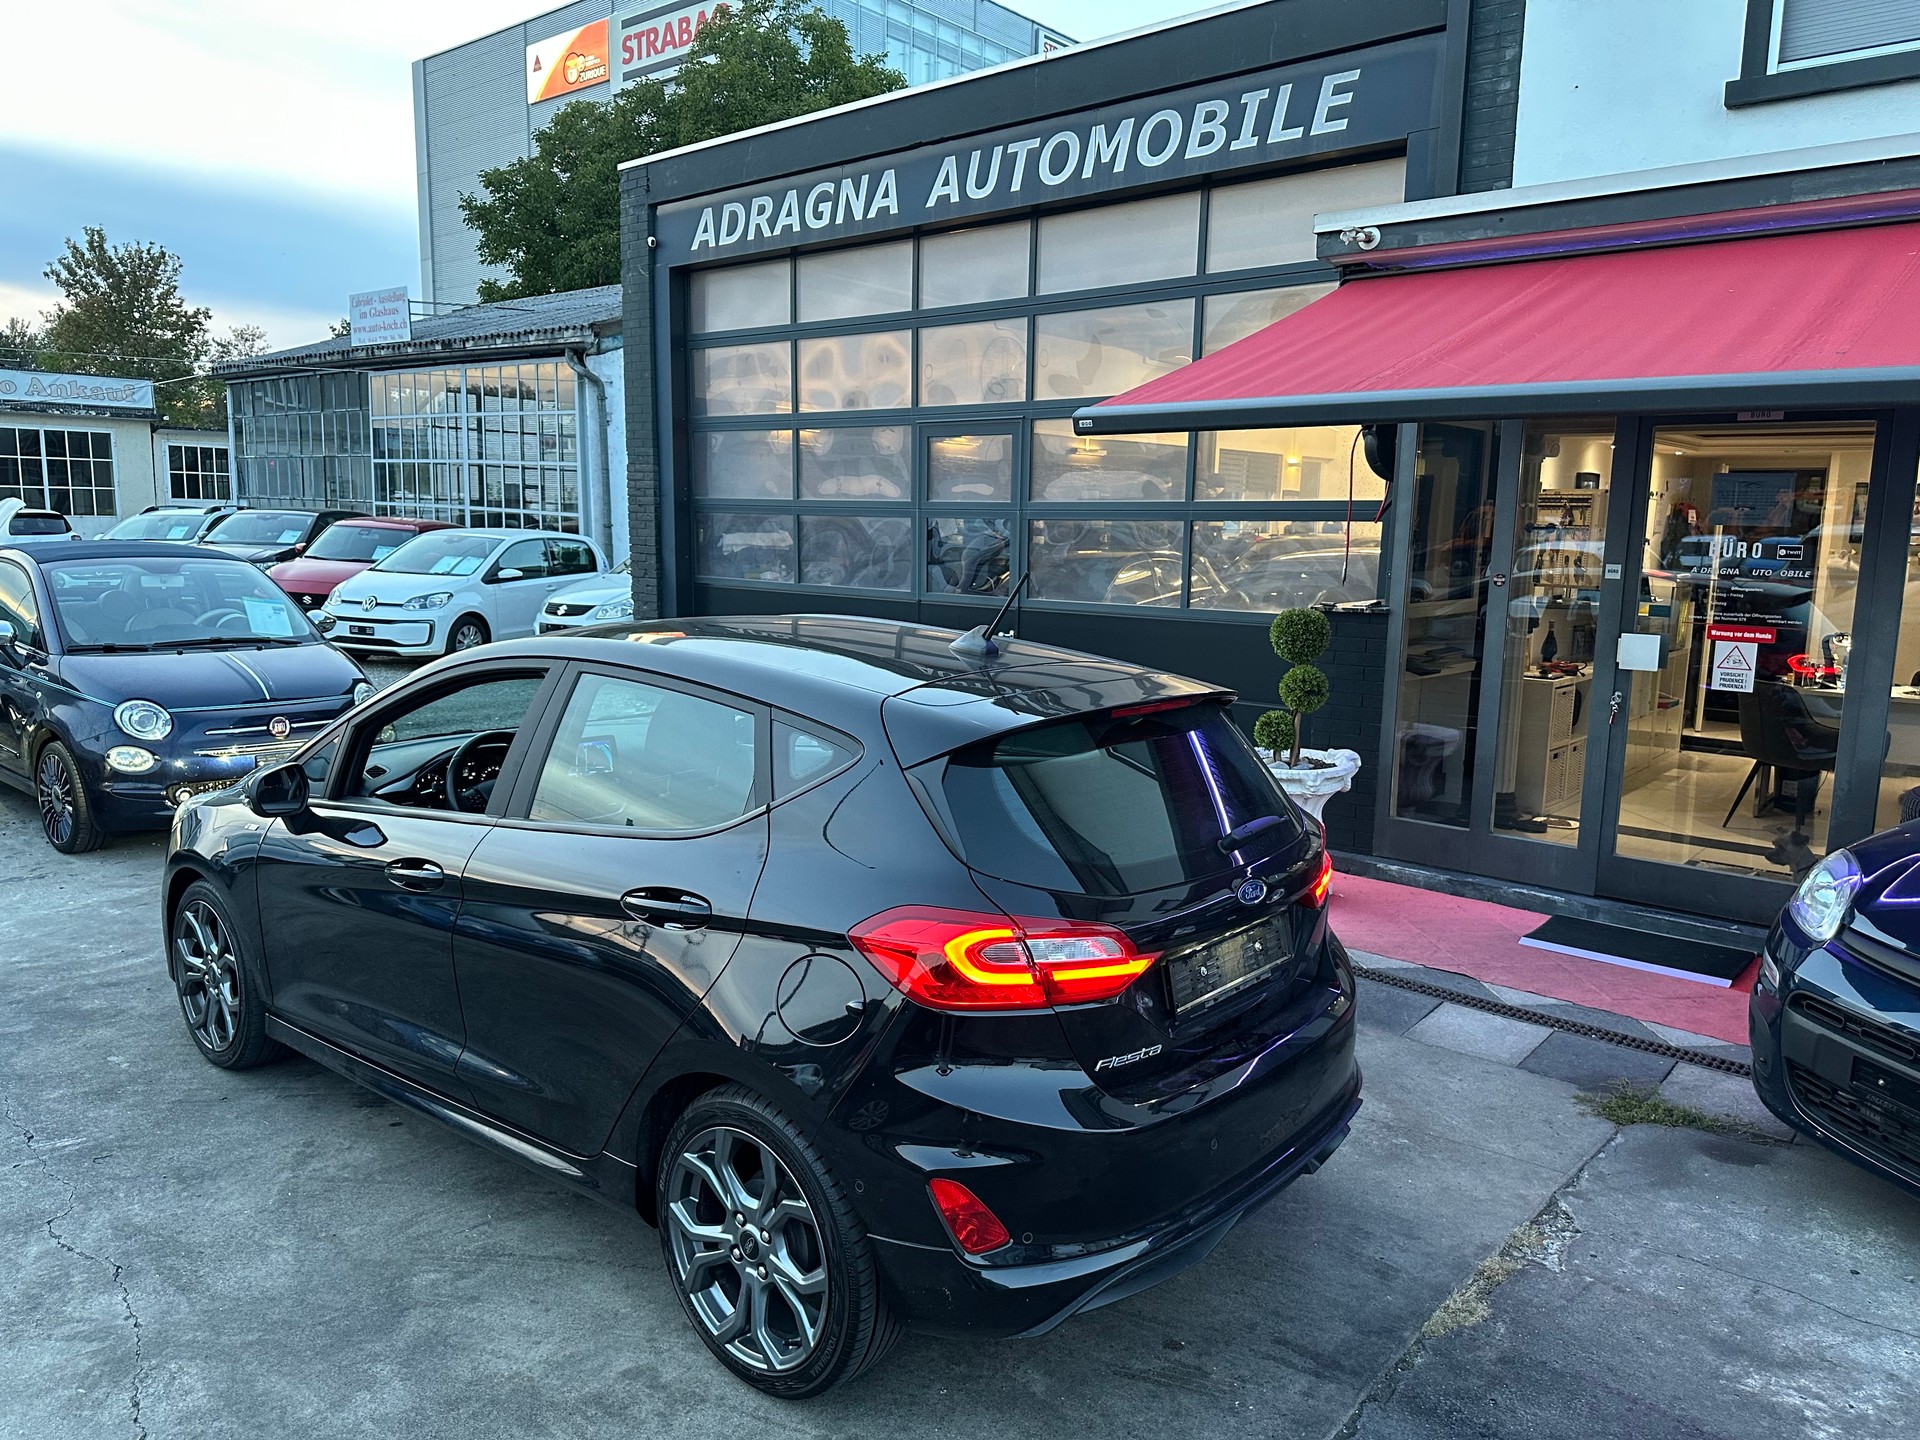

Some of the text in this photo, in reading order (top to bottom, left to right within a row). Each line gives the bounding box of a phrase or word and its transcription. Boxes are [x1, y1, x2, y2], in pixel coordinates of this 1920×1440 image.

[621, 3, 729, 66] STRABA
[690, 68, 1361, 252] ADRAGNA AUTOMOBILE
[359, 306, 399, 319] im Glashaus
[353, 318, 408, 334] www.auto-koch.ch
[25, 376, 136, 402] Ankauf
[1708, 538, 1763, 559] BÜRO
[1711, 629, 1734, 638] Warnung
[1743, 631, 1755, 639] dem
[1245, 884, 1262, 900] Ford
[1094, 1044, 1162, 1072] Fiesta
[809, 1335, 838, 1377] YOKOHAMA
